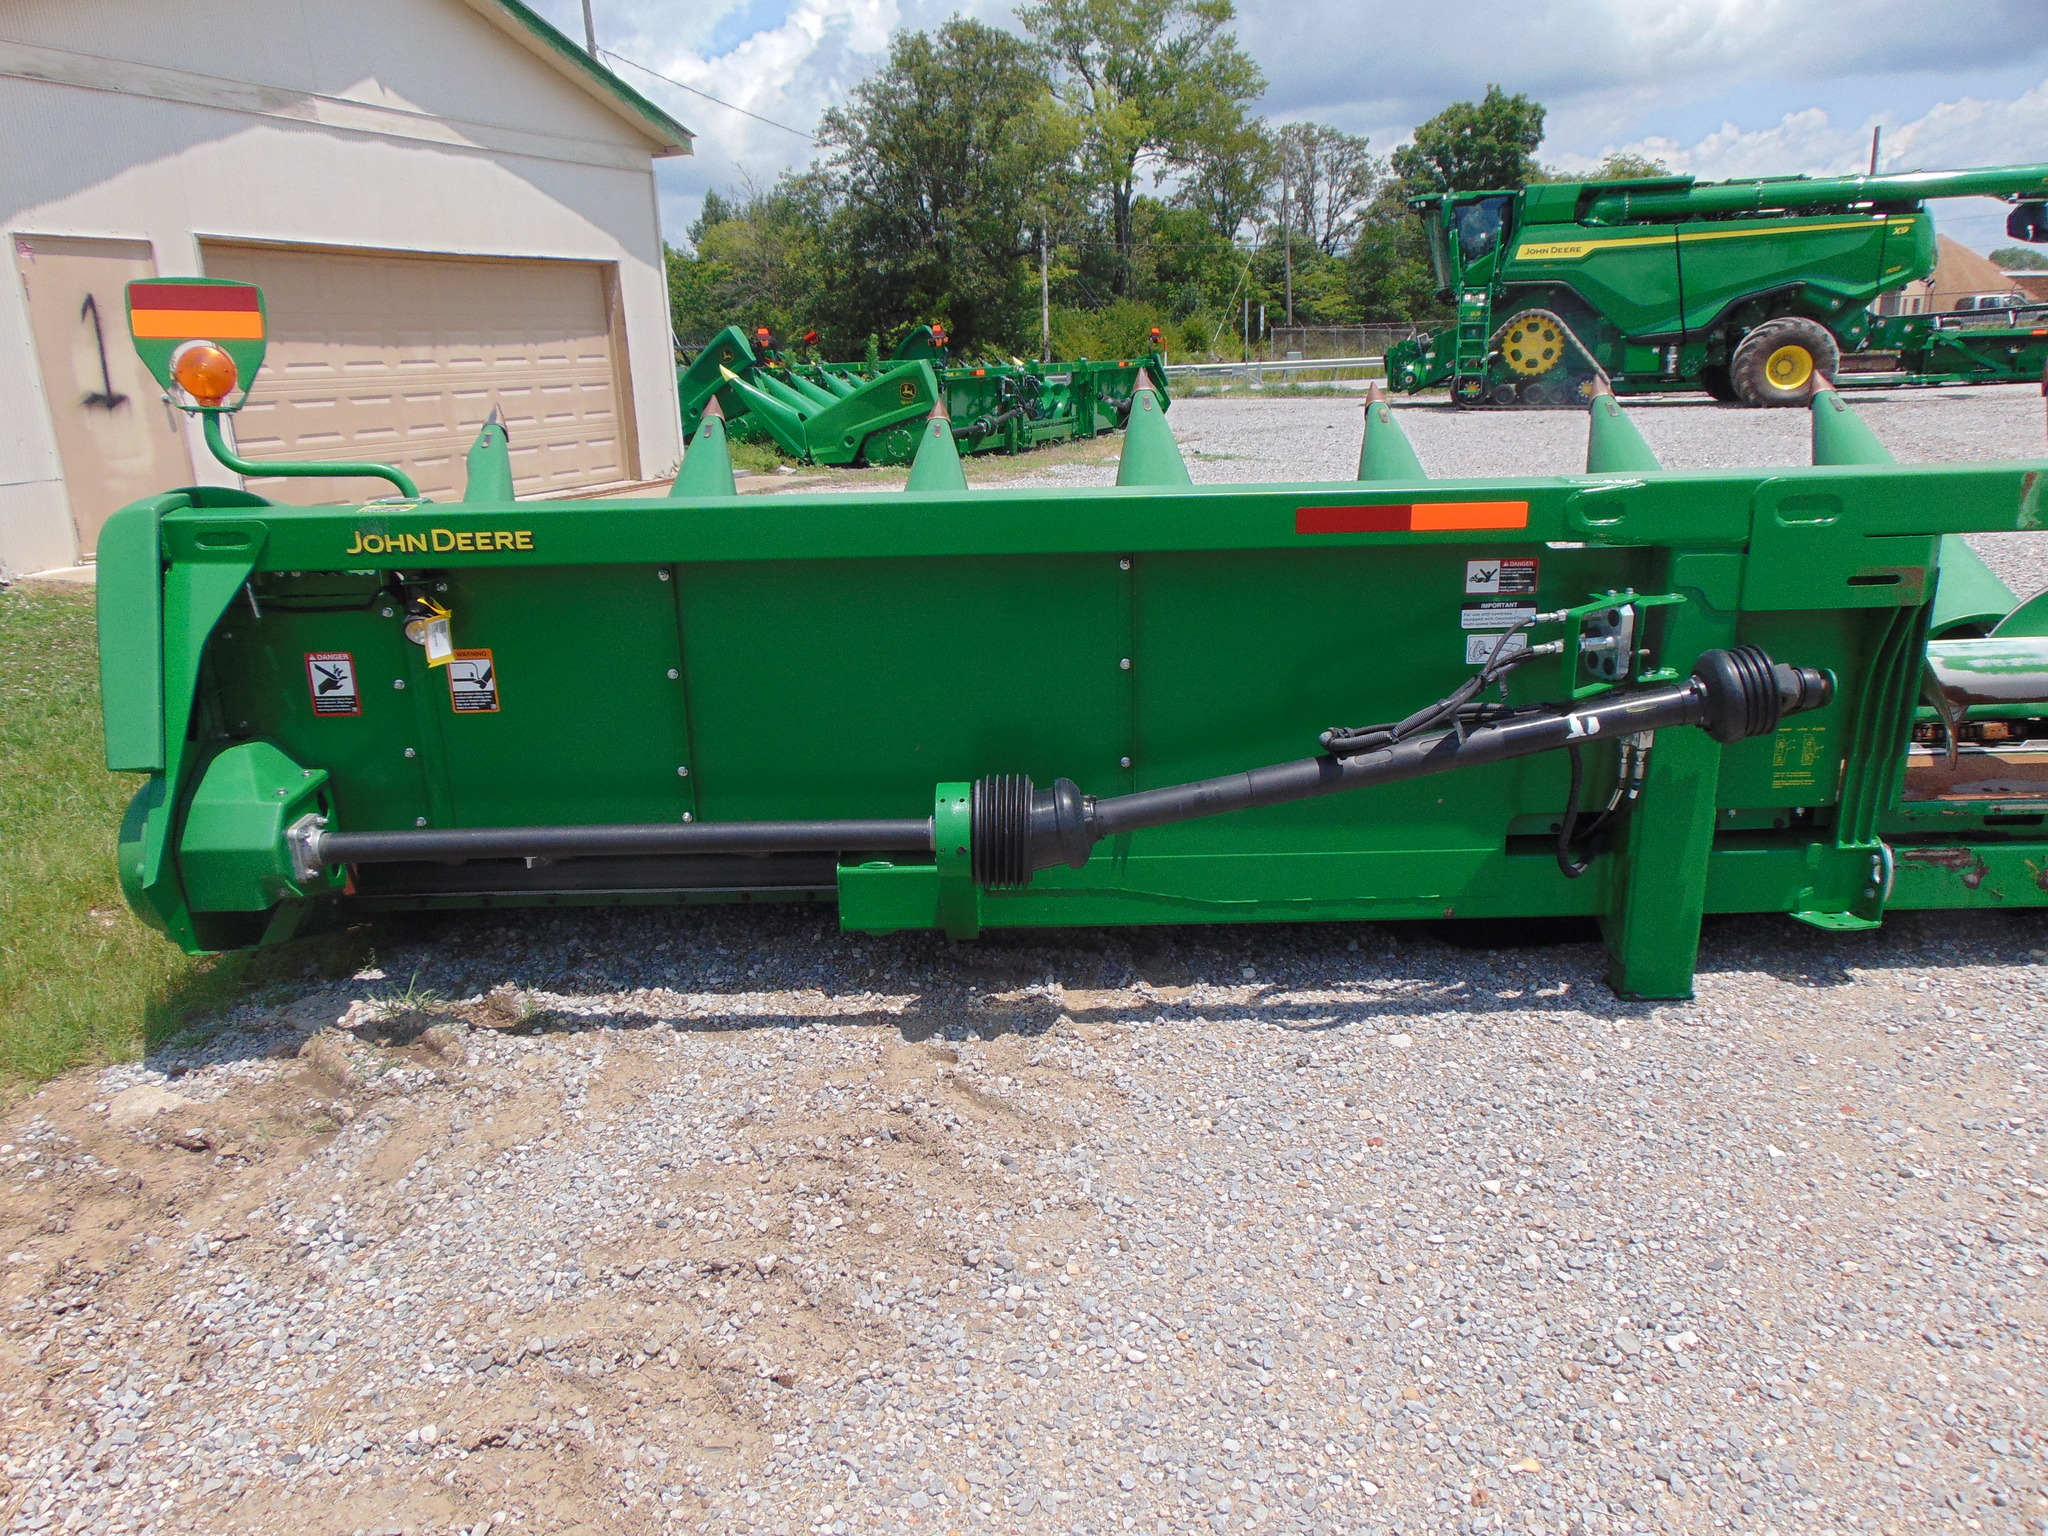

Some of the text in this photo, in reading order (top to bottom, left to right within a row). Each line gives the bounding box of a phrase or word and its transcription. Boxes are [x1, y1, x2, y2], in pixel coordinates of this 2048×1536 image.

[1550, 246, 1582, 254] DEERE
[347, 528, 535, 554] JOHN DEERE
